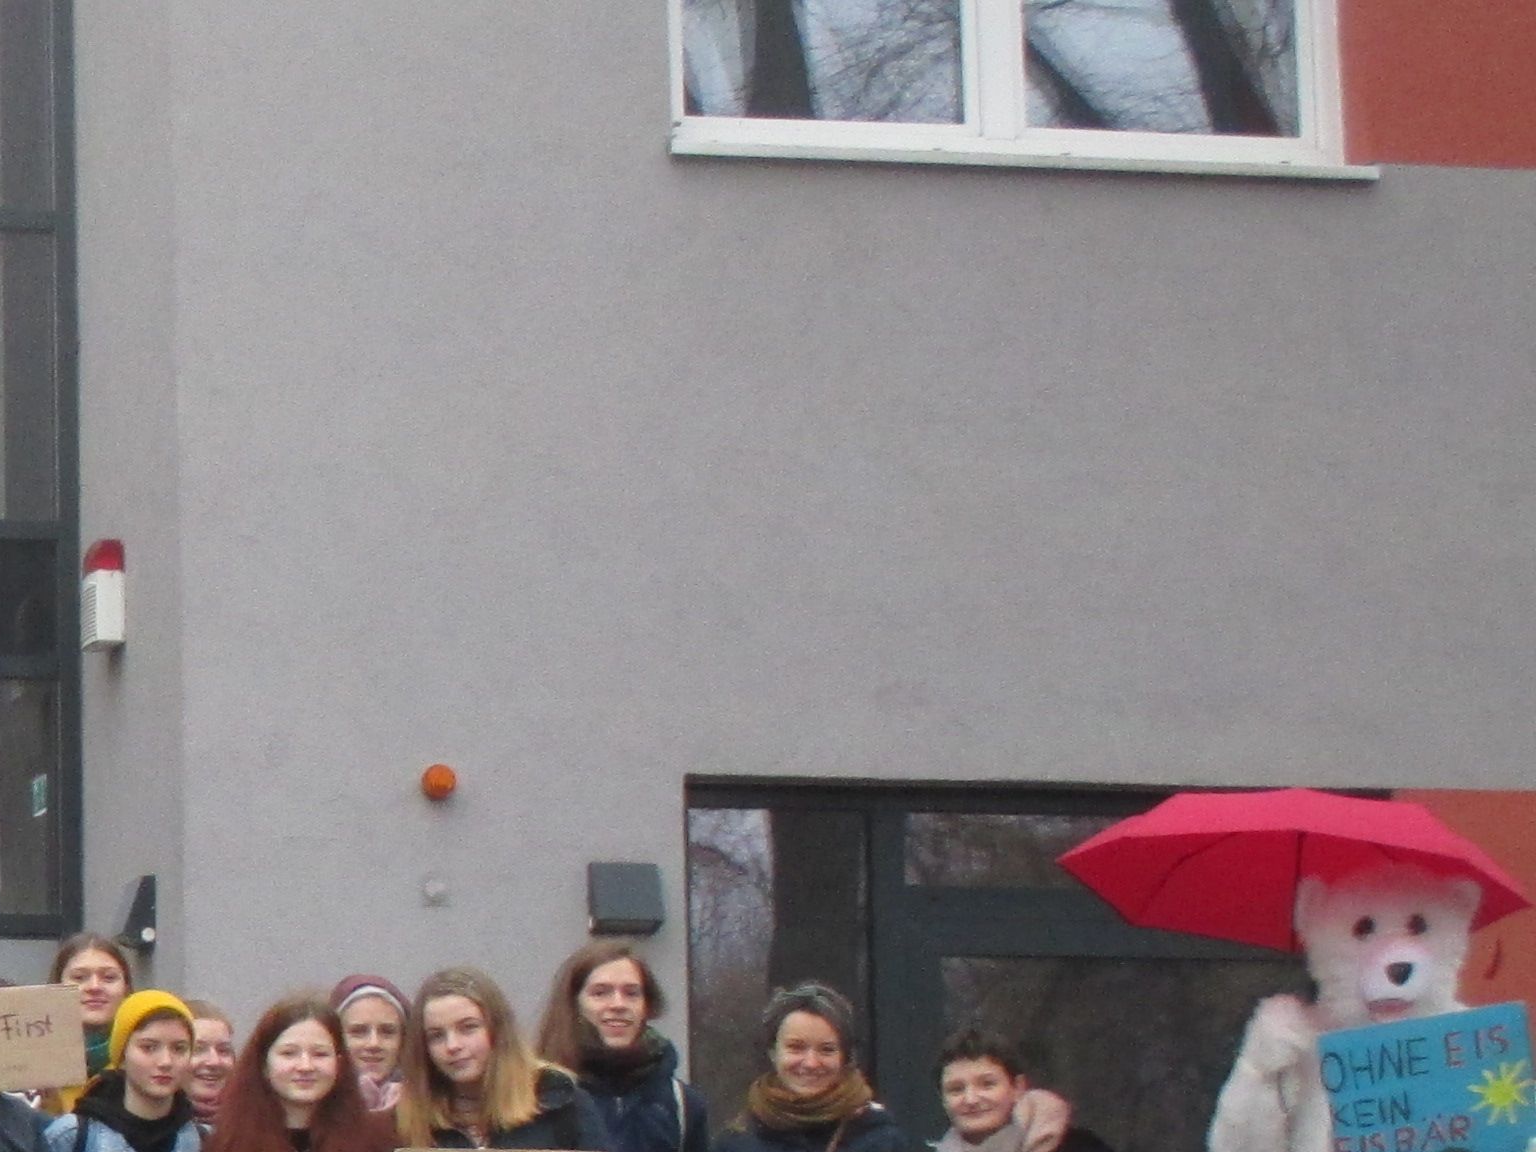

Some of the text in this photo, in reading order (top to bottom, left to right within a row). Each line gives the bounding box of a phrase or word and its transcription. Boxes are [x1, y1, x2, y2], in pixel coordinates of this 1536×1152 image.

[1320, 1025, 1510, 1094] OHNE EIS
[1330, 1090, 1411, 1128] KEIN
